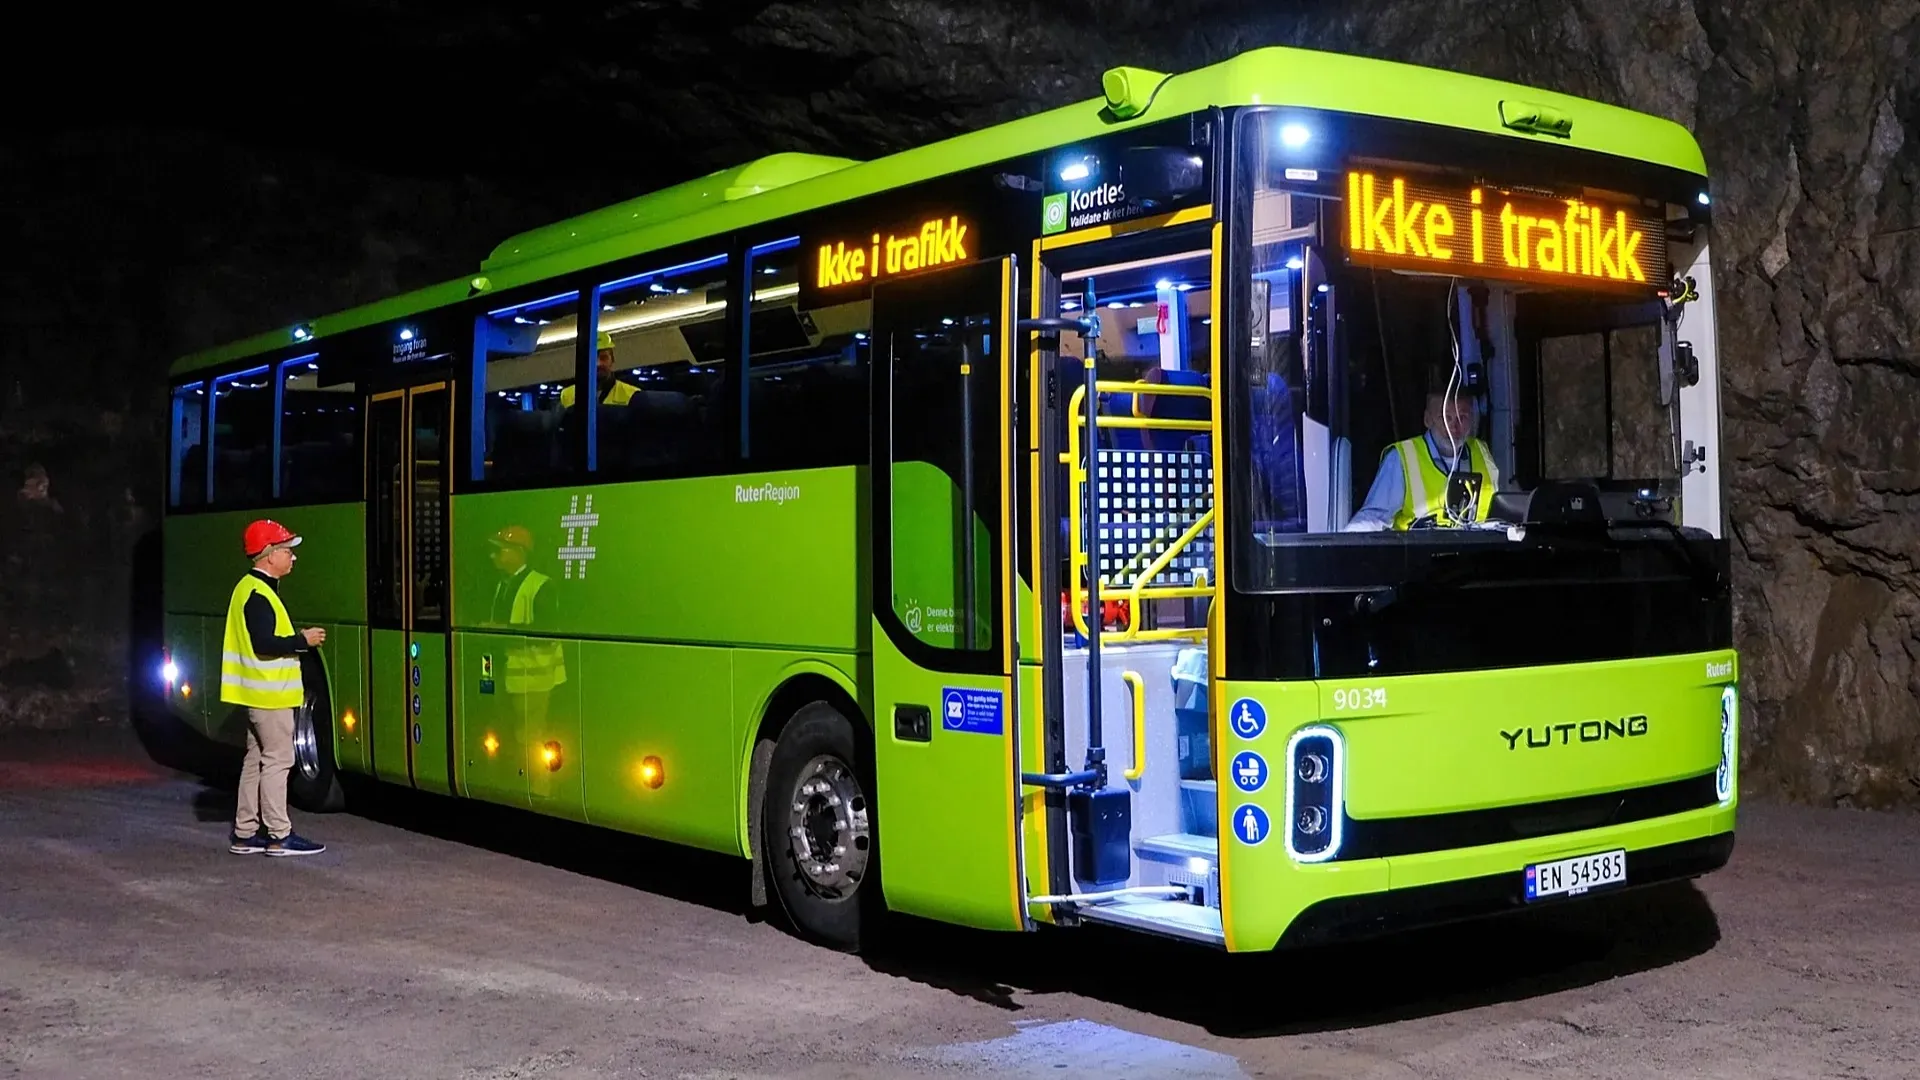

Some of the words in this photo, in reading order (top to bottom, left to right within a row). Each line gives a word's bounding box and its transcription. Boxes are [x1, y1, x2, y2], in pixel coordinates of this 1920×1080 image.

[1070, 212, 1102, 228] Validate
[1102, 207, 1125, 221] ticket
[1349, 172, 1454, 260] Ikke
[1471, 188, 1484, 264] i
[1500, 199, 1645, 282] trafikk
[818, 241, 866, 288] Ikke
[871, 233, 880, 277] i
[886, 215, 967, 274] trafikk
[735, 480, 800, 506] RuterRegion
[927, 606, 949, 618] Denne
[927, 623, 934, 632] er
[935, 622, 964, 633] elektr
[1500, 715, 1648, 751] YUTONG
[1540, 866, 1562, 892] EN
[1571, 855, 1622, 886] 54585
